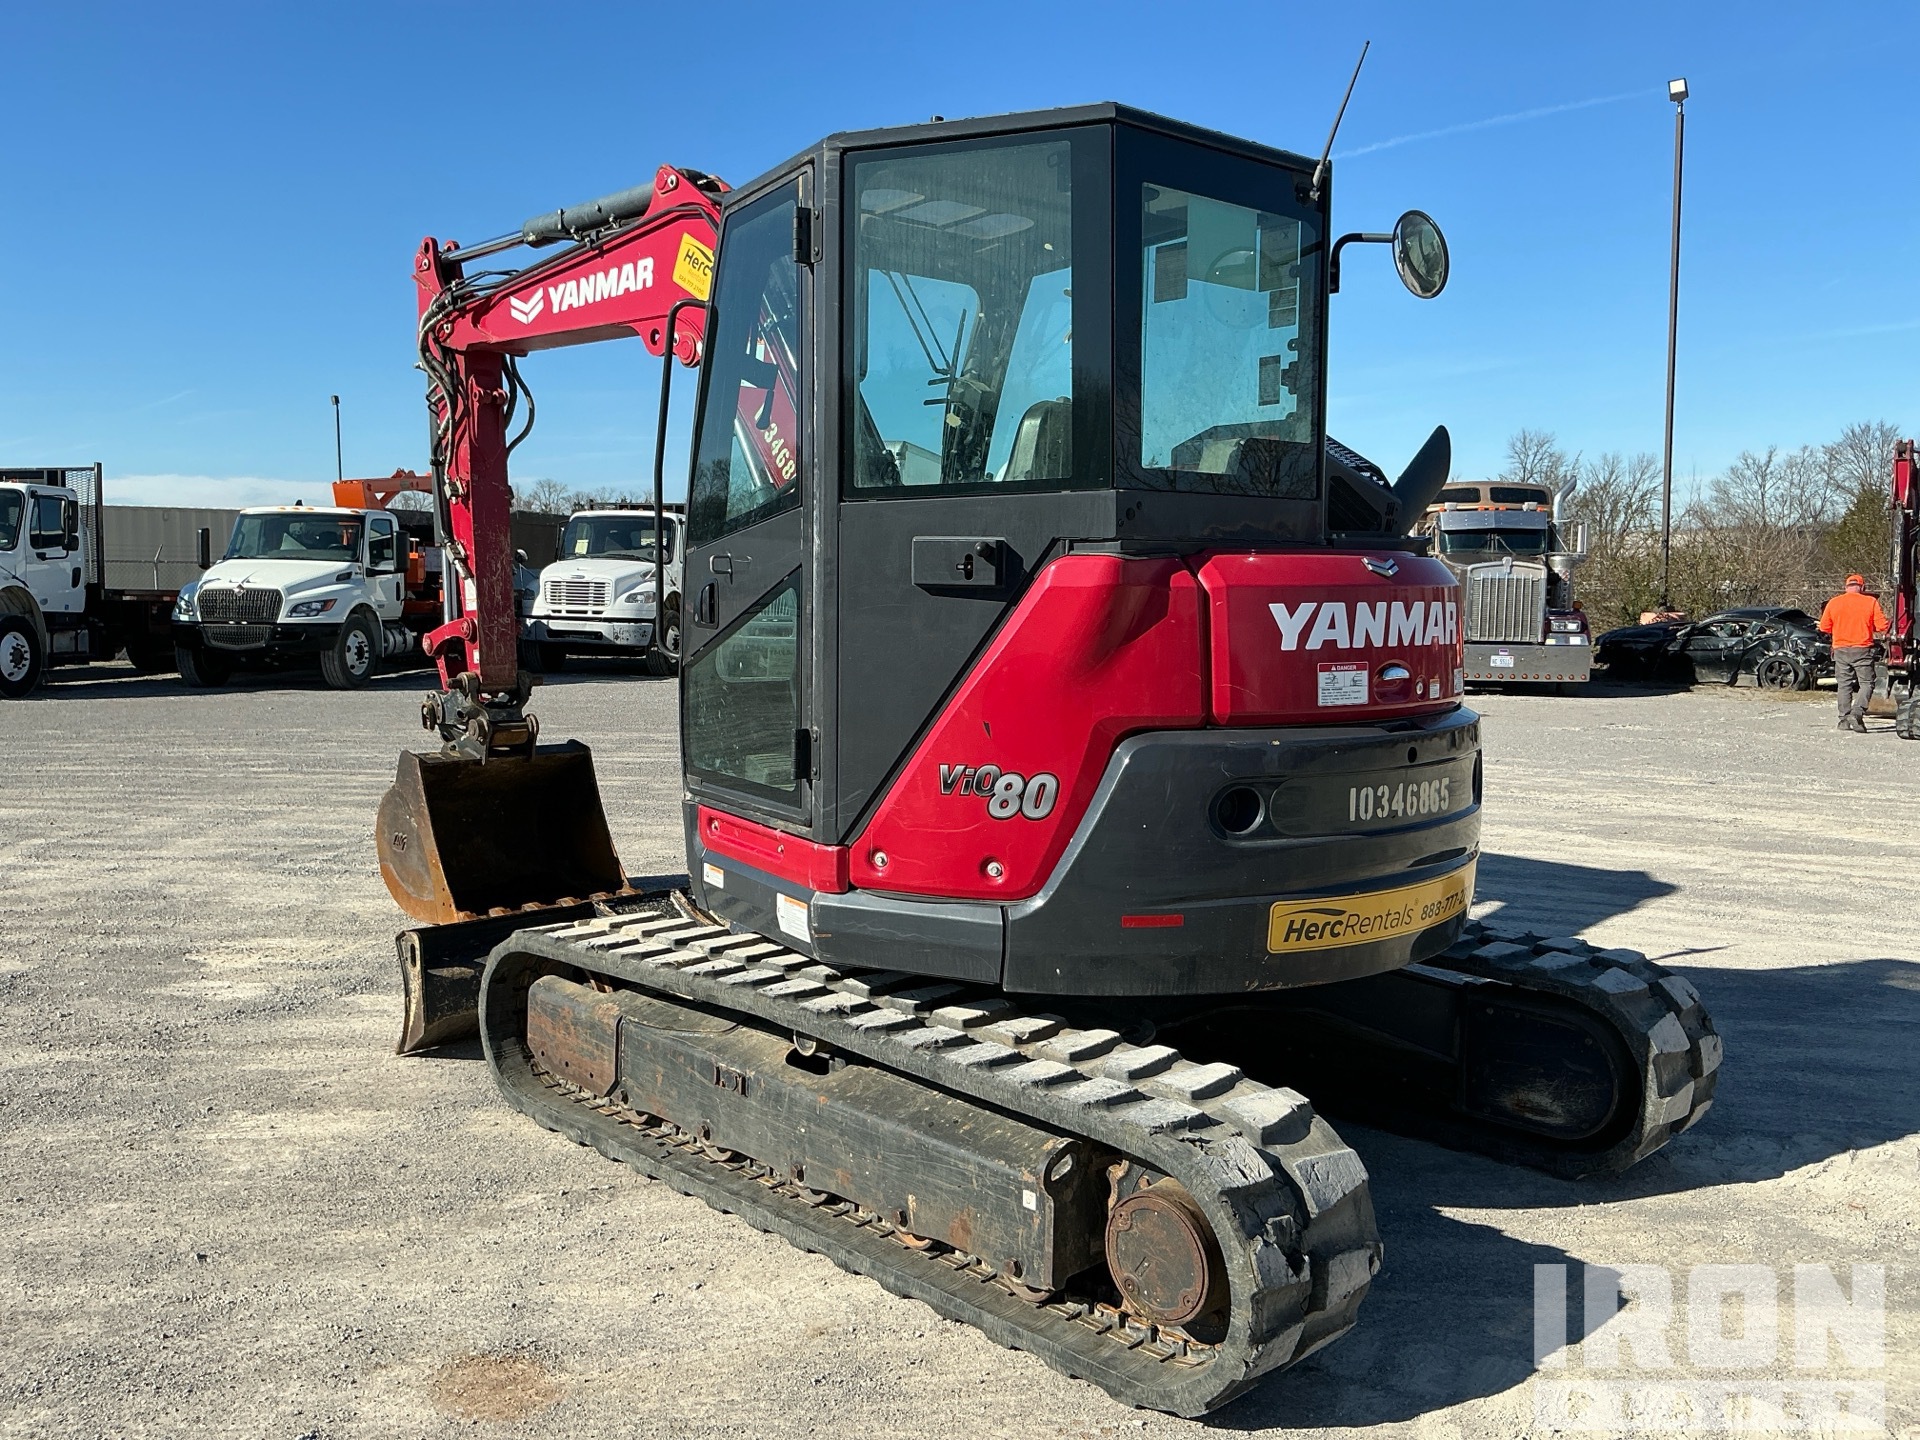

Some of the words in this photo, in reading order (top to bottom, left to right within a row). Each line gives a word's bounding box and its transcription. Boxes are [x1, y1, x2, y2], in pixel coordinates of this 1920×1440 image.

[548, 256, 654, 314] YANMAR
[683, 248, 711, 276] Herc
[757, 411, 796, 480] 3468
[1268, 602, 1457, 650] YANMAR
[1350, 777, 1449, 821] 10346865
